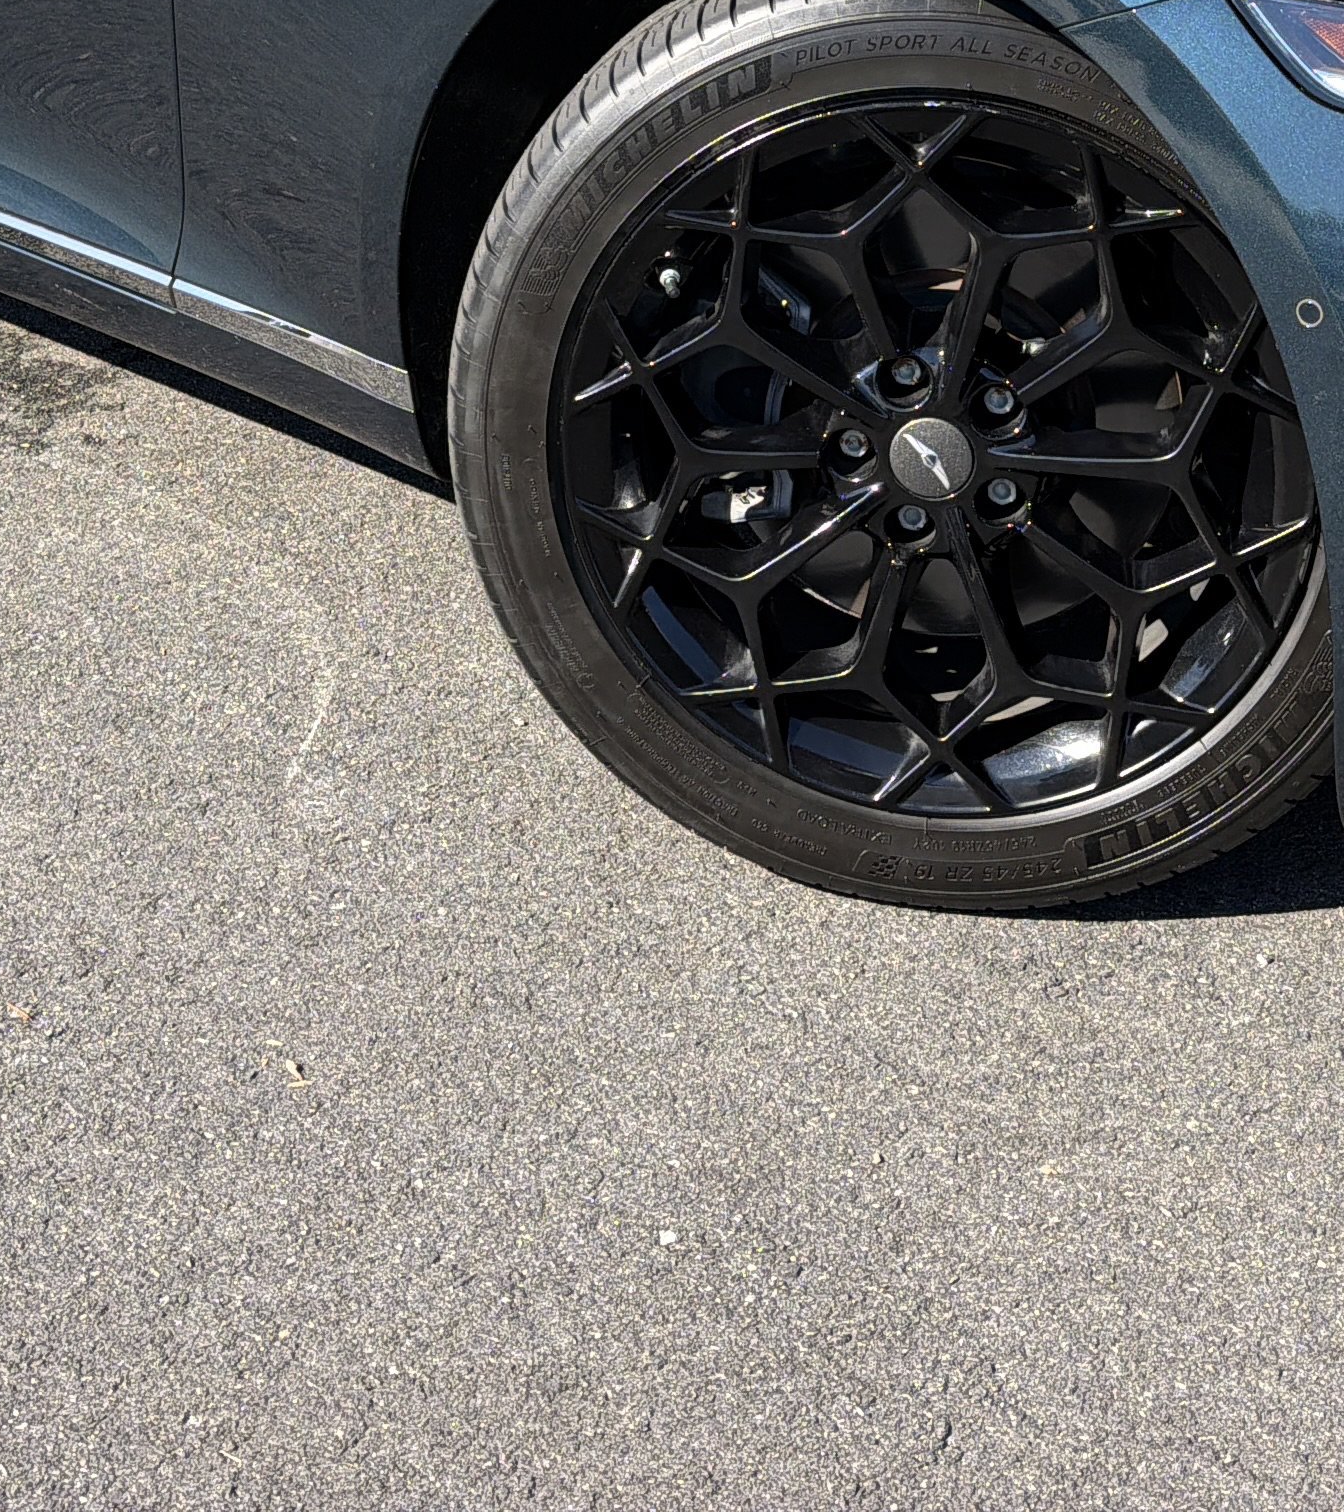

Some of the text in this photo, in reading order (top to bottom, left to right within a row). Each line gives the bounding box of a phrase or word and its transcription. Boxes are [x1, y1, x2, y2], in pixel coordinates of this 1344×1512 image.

[795, 34, 1102, 83] PILOT SPORT ALL SEASON
[555, 62, 757, 237] MICHELIN
[1099, 698, 1308, 860] MICHELIN
[913, 856, 1065, 882] 245/45 ZR 19
